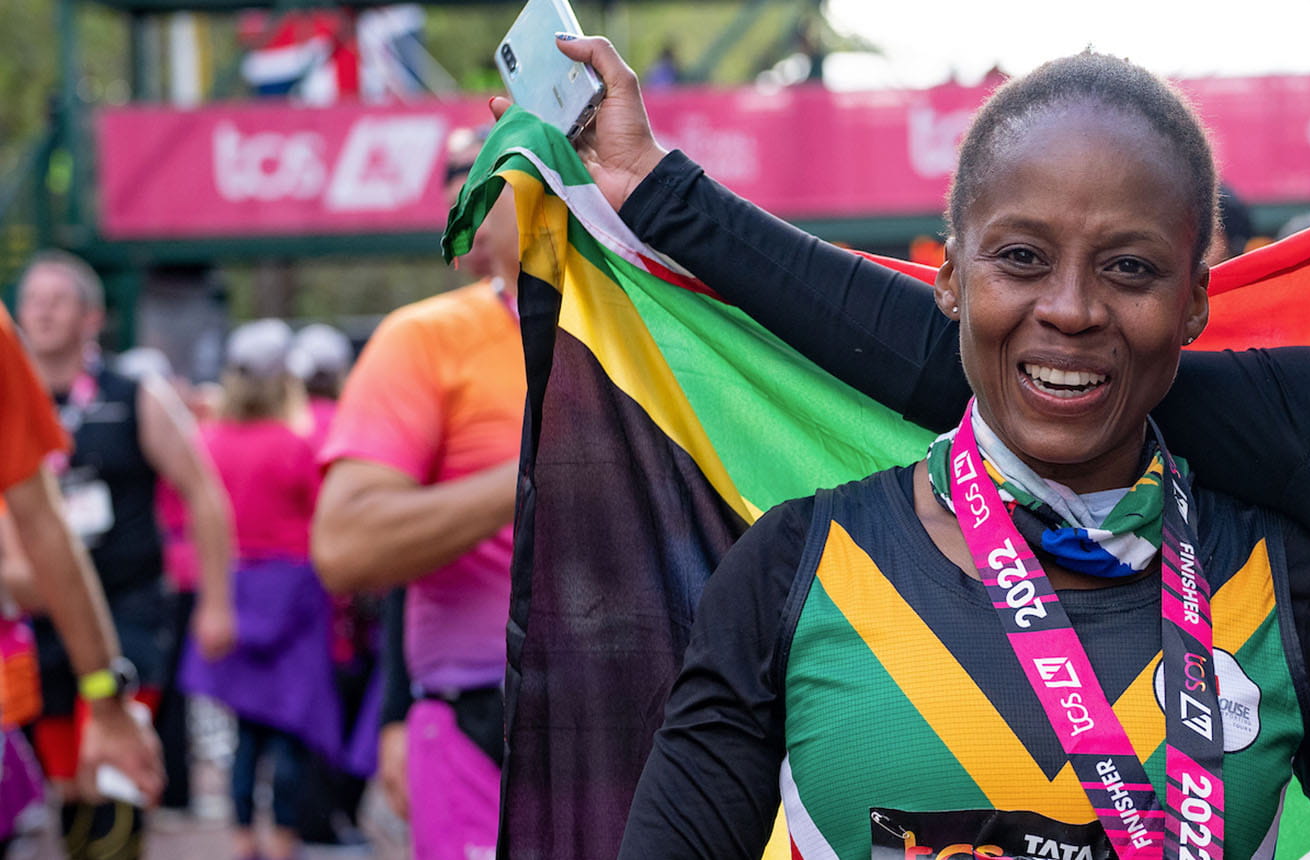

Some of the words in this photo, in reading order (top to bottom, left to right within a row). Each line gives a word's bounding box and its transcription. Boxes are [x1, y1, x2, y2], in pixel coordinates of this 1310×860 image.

[965, 482, 990, 528] tcs
[988, 538, 1048, 628] 2022
[1179, 541, 1200, 625] FINISHER
[1184, 652, 1207, 692] tcs
[1060, 692, 1094, 736] tcs
[1219, 698, 1250, 720] OUSE
[1096, 758, 1153, 849] FINISHER
[1180, 772, 1212, 860] 2022
[1024, 834, 1093, 860] TATA
